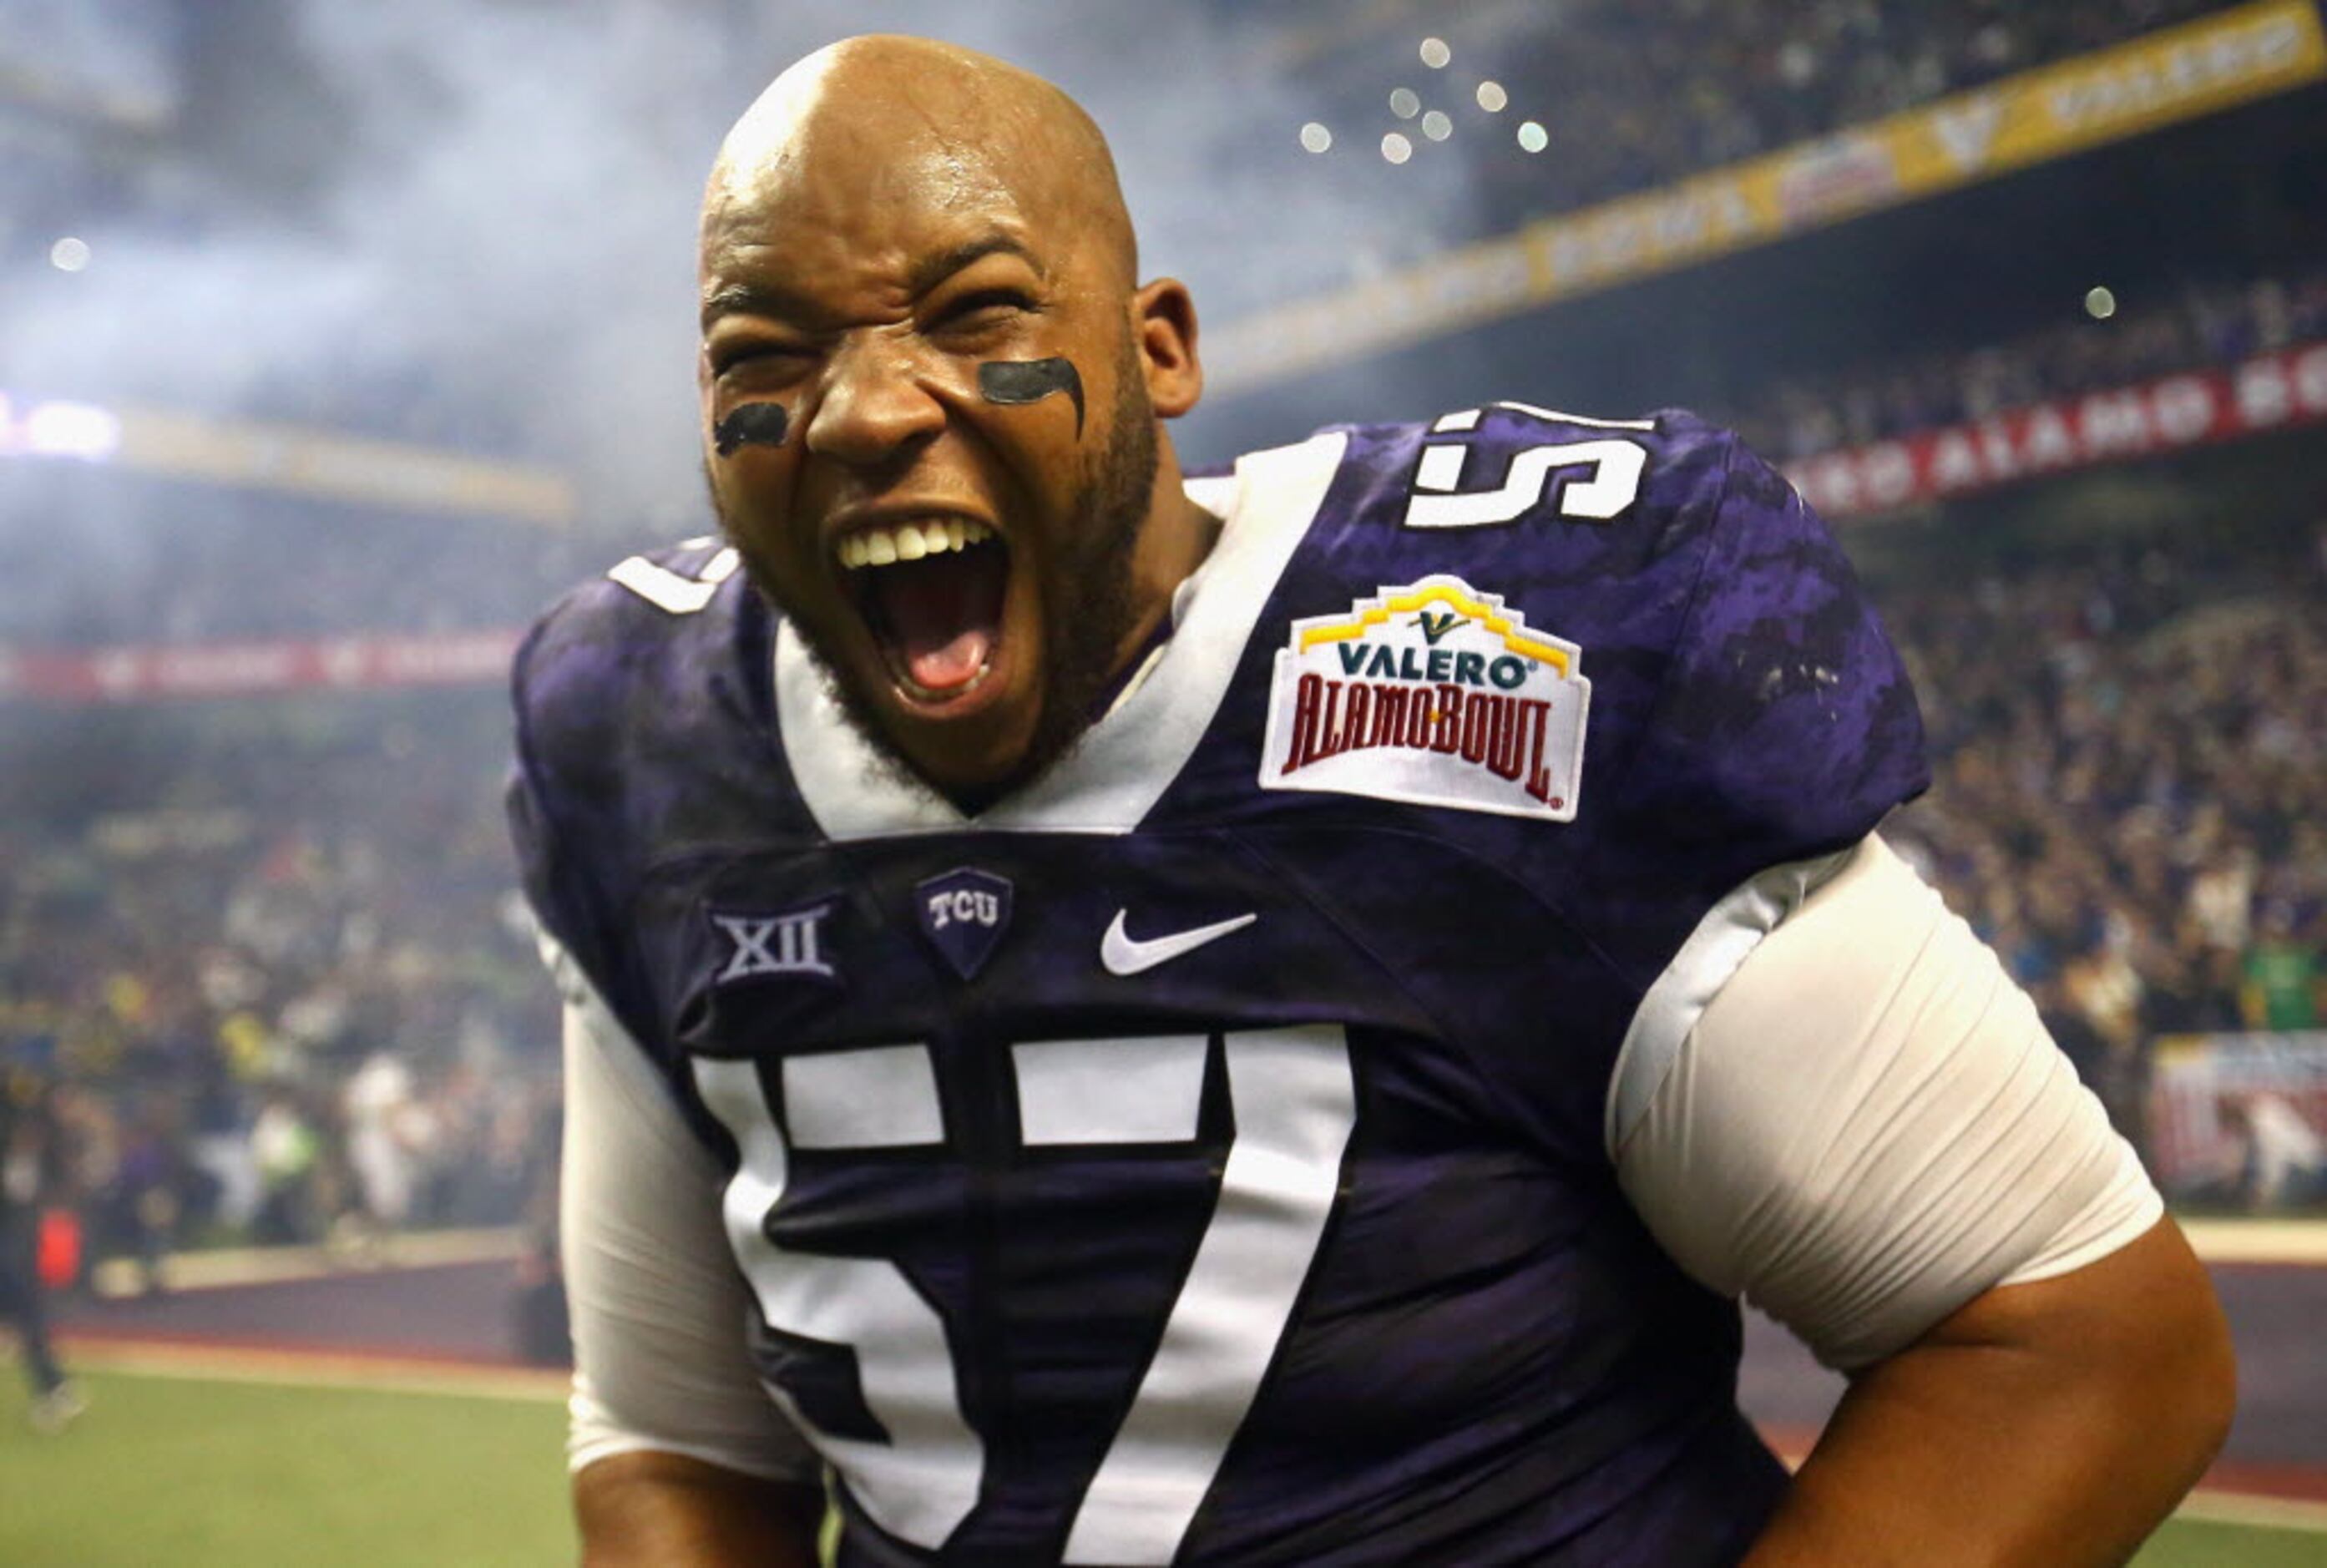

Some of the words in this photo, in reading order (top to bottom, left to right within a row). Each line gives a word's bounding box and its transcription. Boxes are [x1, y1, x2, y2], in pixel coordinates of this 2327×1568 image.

[1933, 374, 2217, 488] ALAMO
[714, 905, 833, 983] XII
[928, 890, 998, 928] TCU
[690, 1024, 1357, 1565] 57
